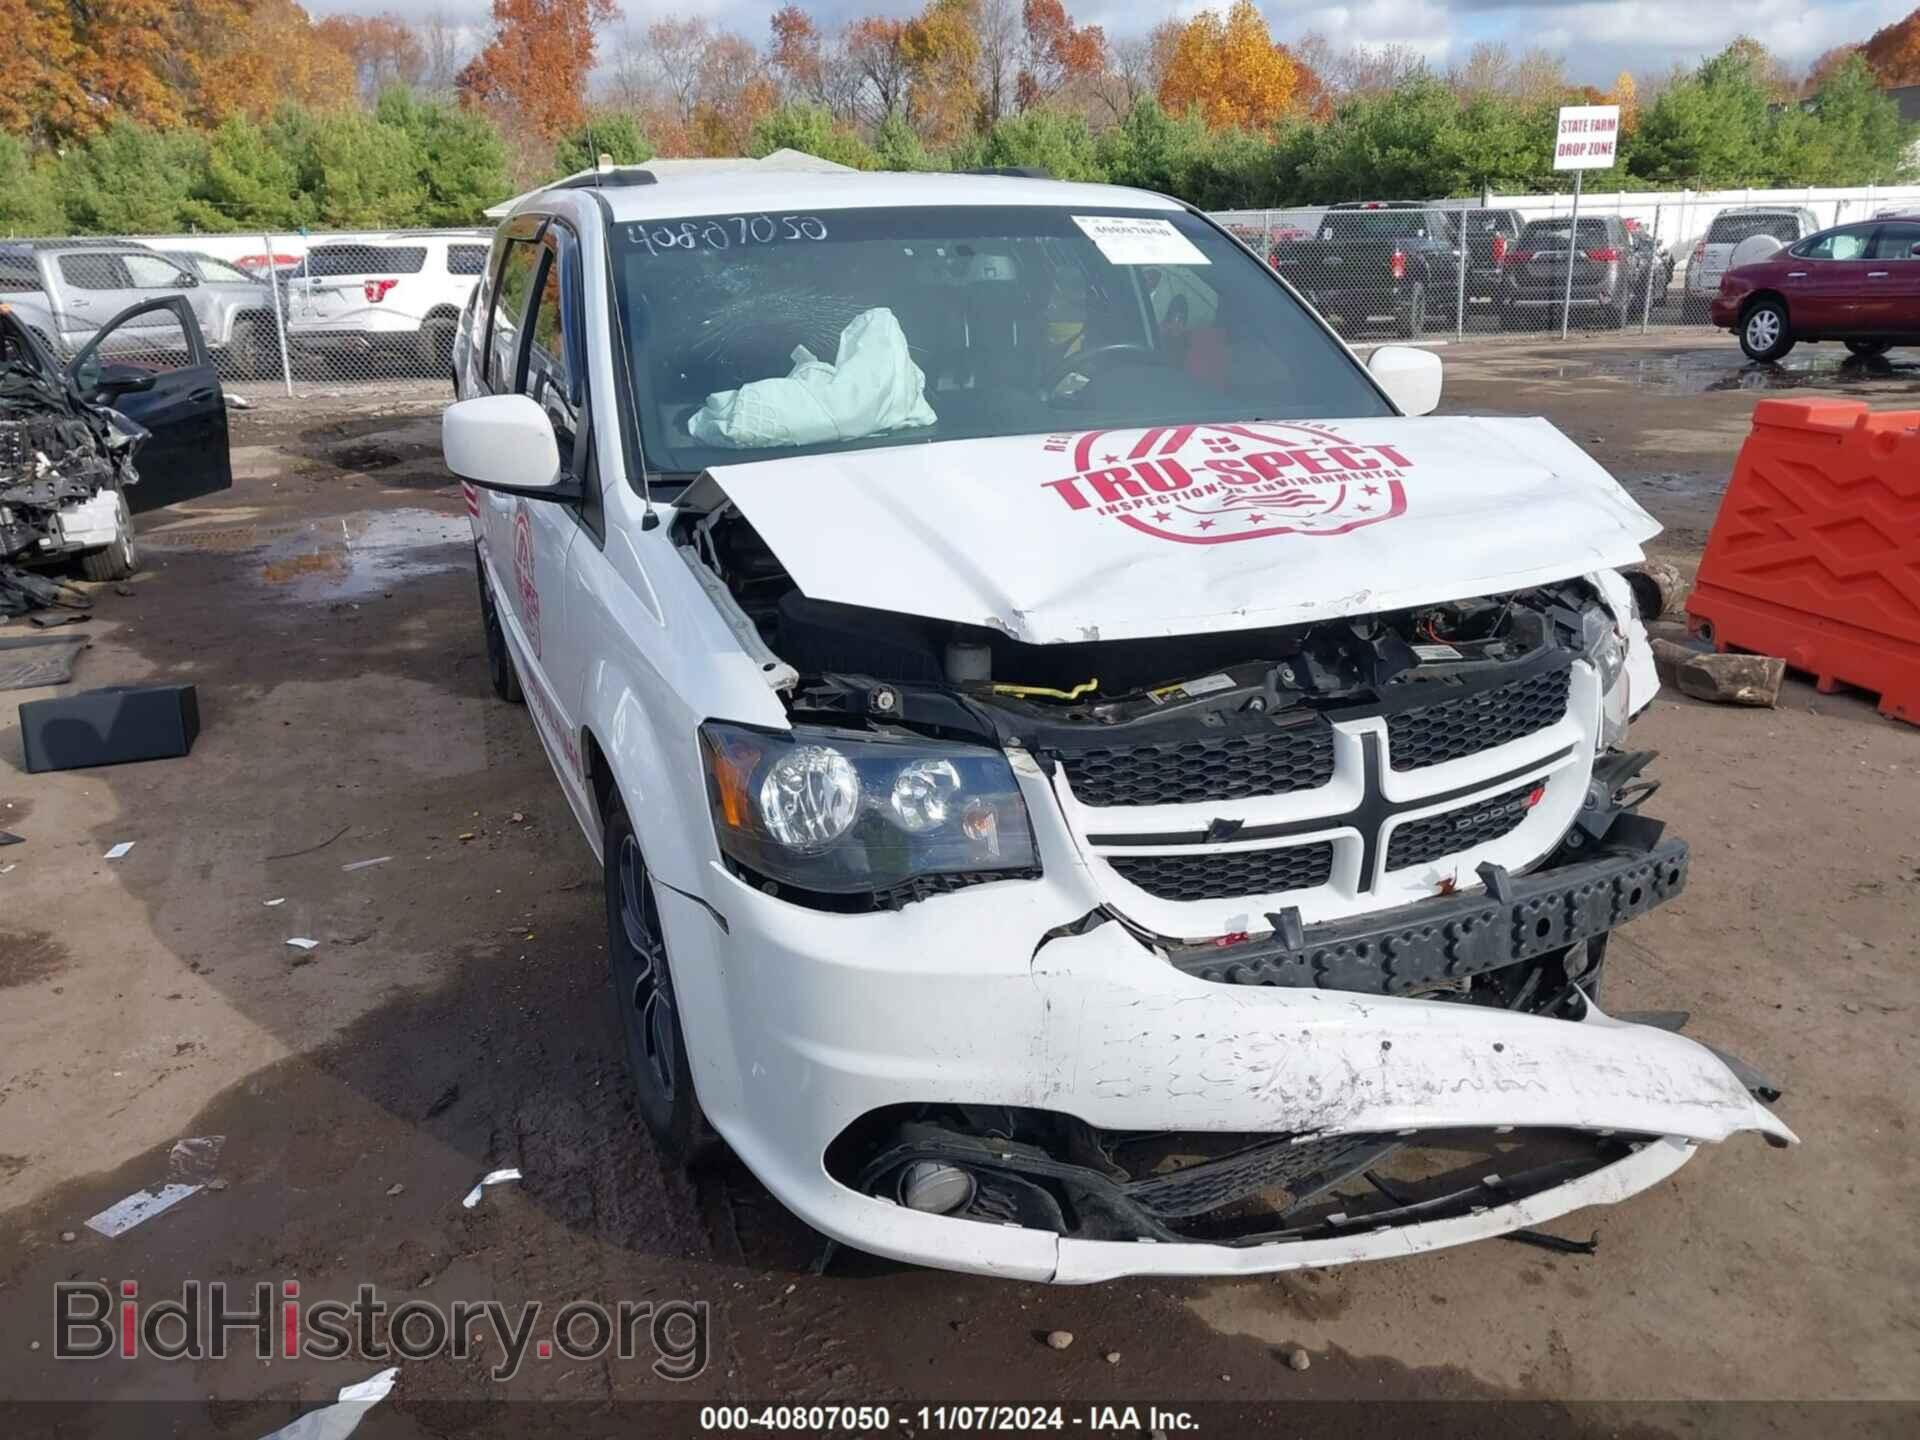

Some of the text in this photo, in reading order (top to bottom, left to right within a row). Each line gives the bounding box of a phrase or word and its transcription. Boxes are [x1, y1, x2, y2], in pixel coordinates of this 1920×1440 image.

[1560, 118, 1616, 133] STATE FARM
[1558, 141, 1613, 157] DROP ZONE
[627, 213, 828, 256] 40807050
[1040, 445, 1414, 511] TRU-SPECT
[1252, 468, 1407, 494] ENVIRONMENTAL
